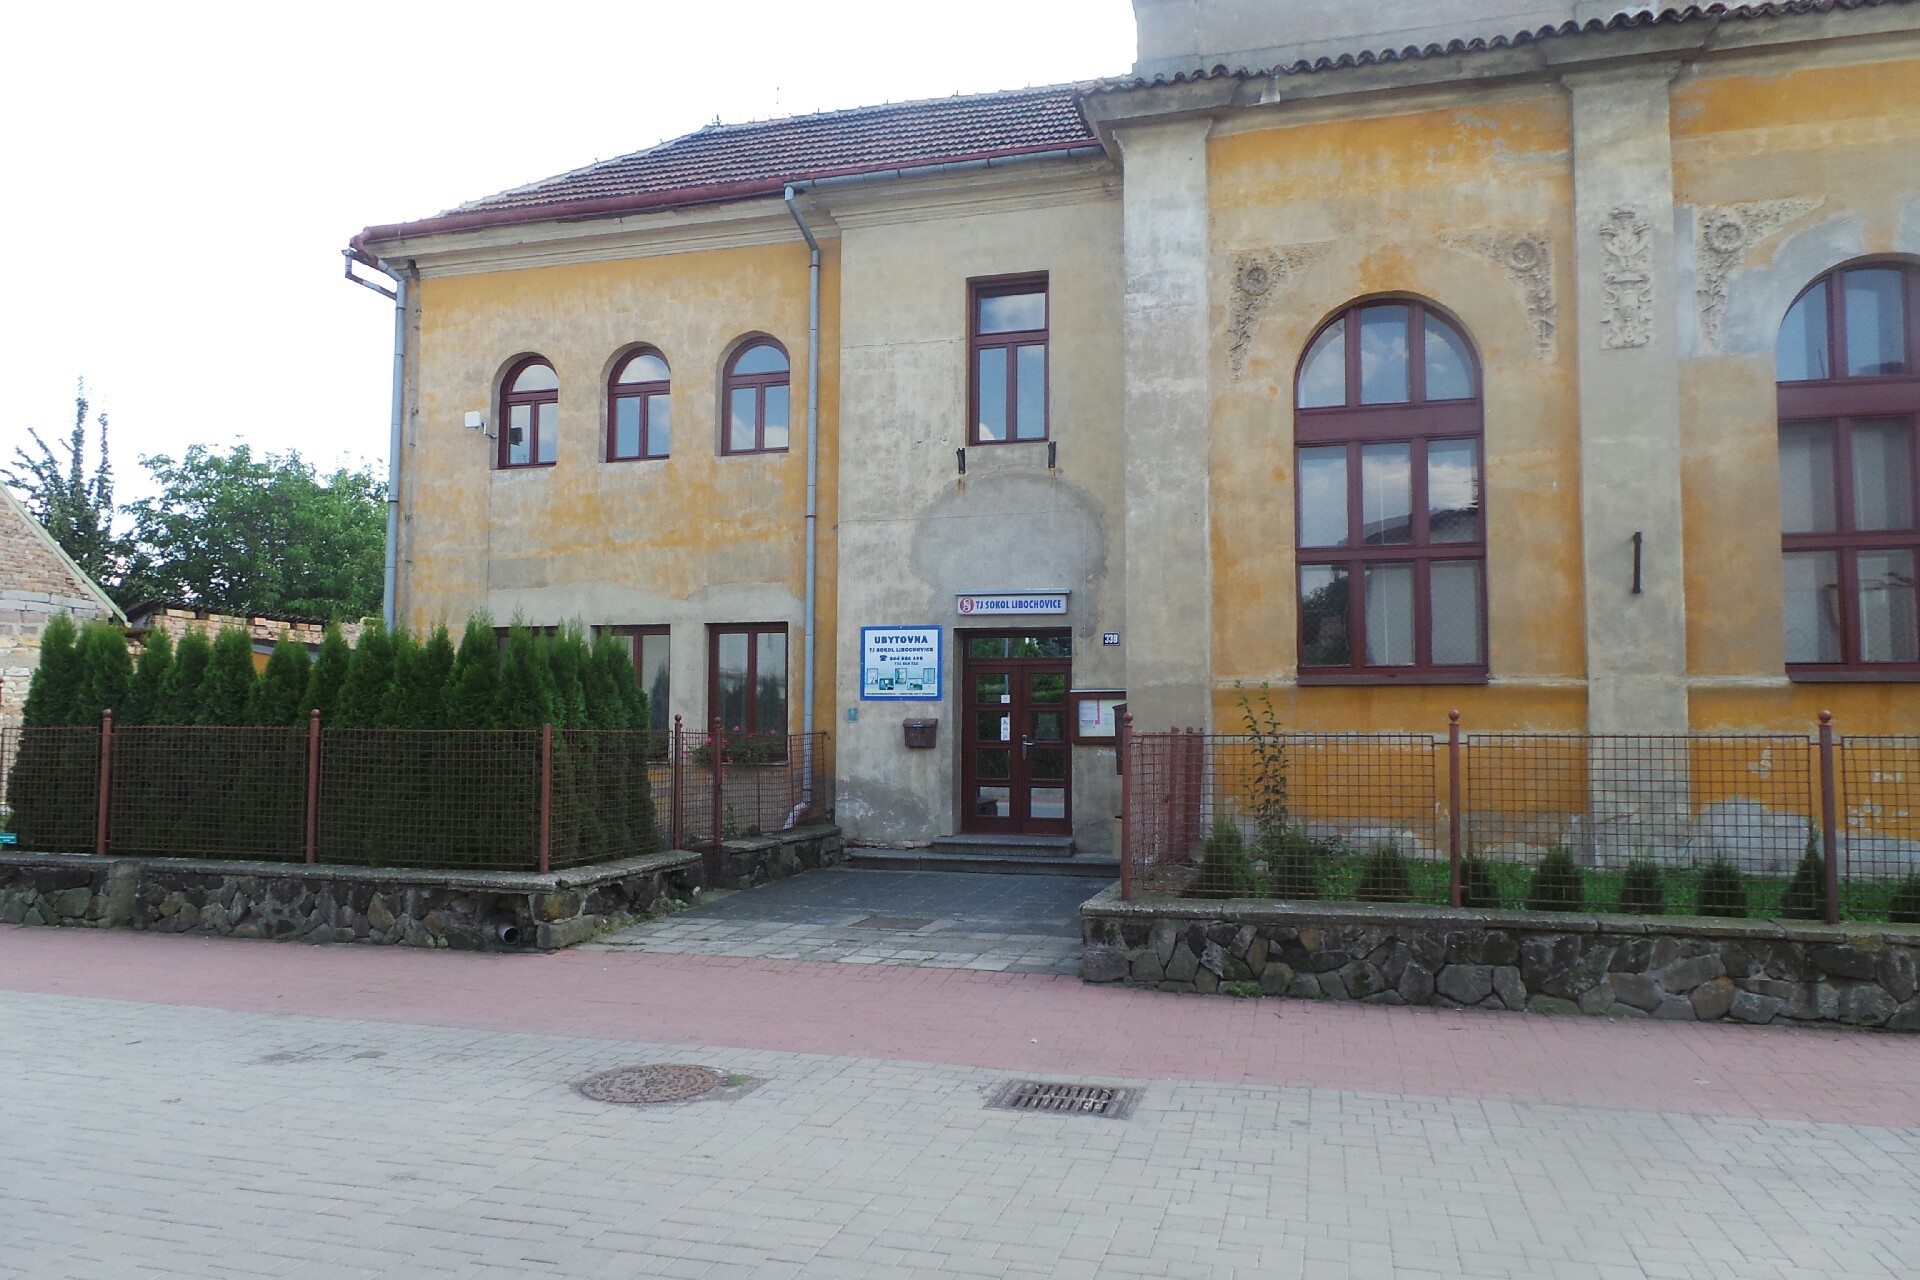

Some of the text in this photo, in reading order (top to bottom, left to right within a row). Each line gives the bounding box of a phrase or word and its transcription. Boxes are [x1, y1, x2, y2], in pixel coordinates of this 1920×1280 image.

[976, 599, 1062, 609] TJ SOKOL LIBOCHOVICE
[874, 635, 928, 644] UBYTOVNA
[1104, 634, 1118, 644] 338
